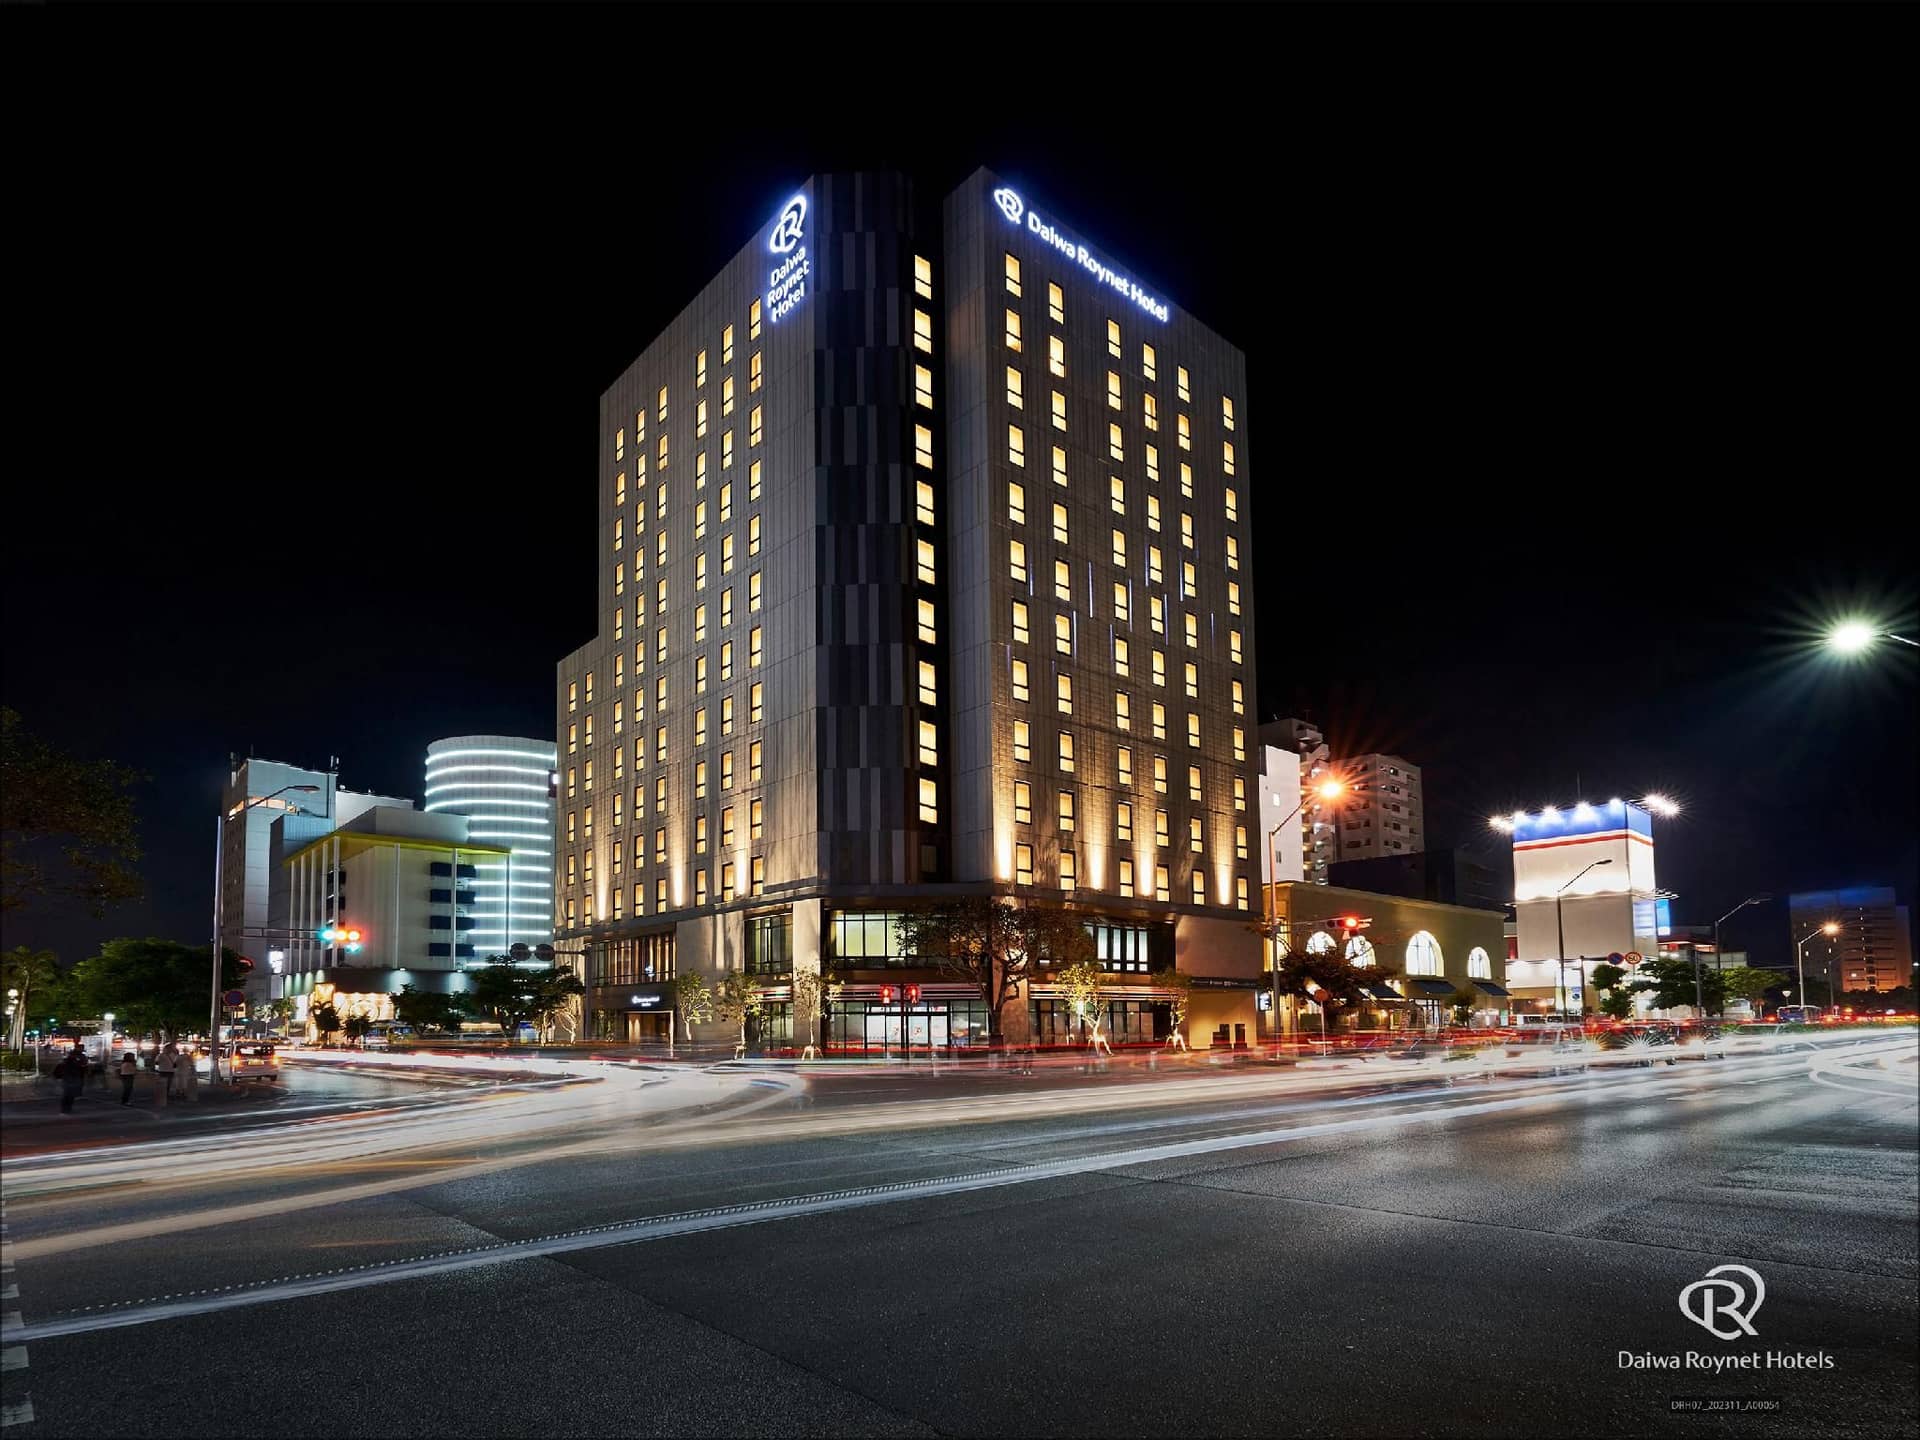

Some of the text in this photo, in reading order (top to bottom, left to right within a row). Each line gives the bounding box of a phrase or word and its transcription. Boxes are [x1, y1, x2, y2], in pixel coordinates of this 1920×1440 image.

[767, 260, 810, 309] Roynet
[770, 246, 806, 288] Daiwa
[1028, 211, 1168, 322] Daiwa Roynet Hotel
[771, 281, 806, 323] Hotel
